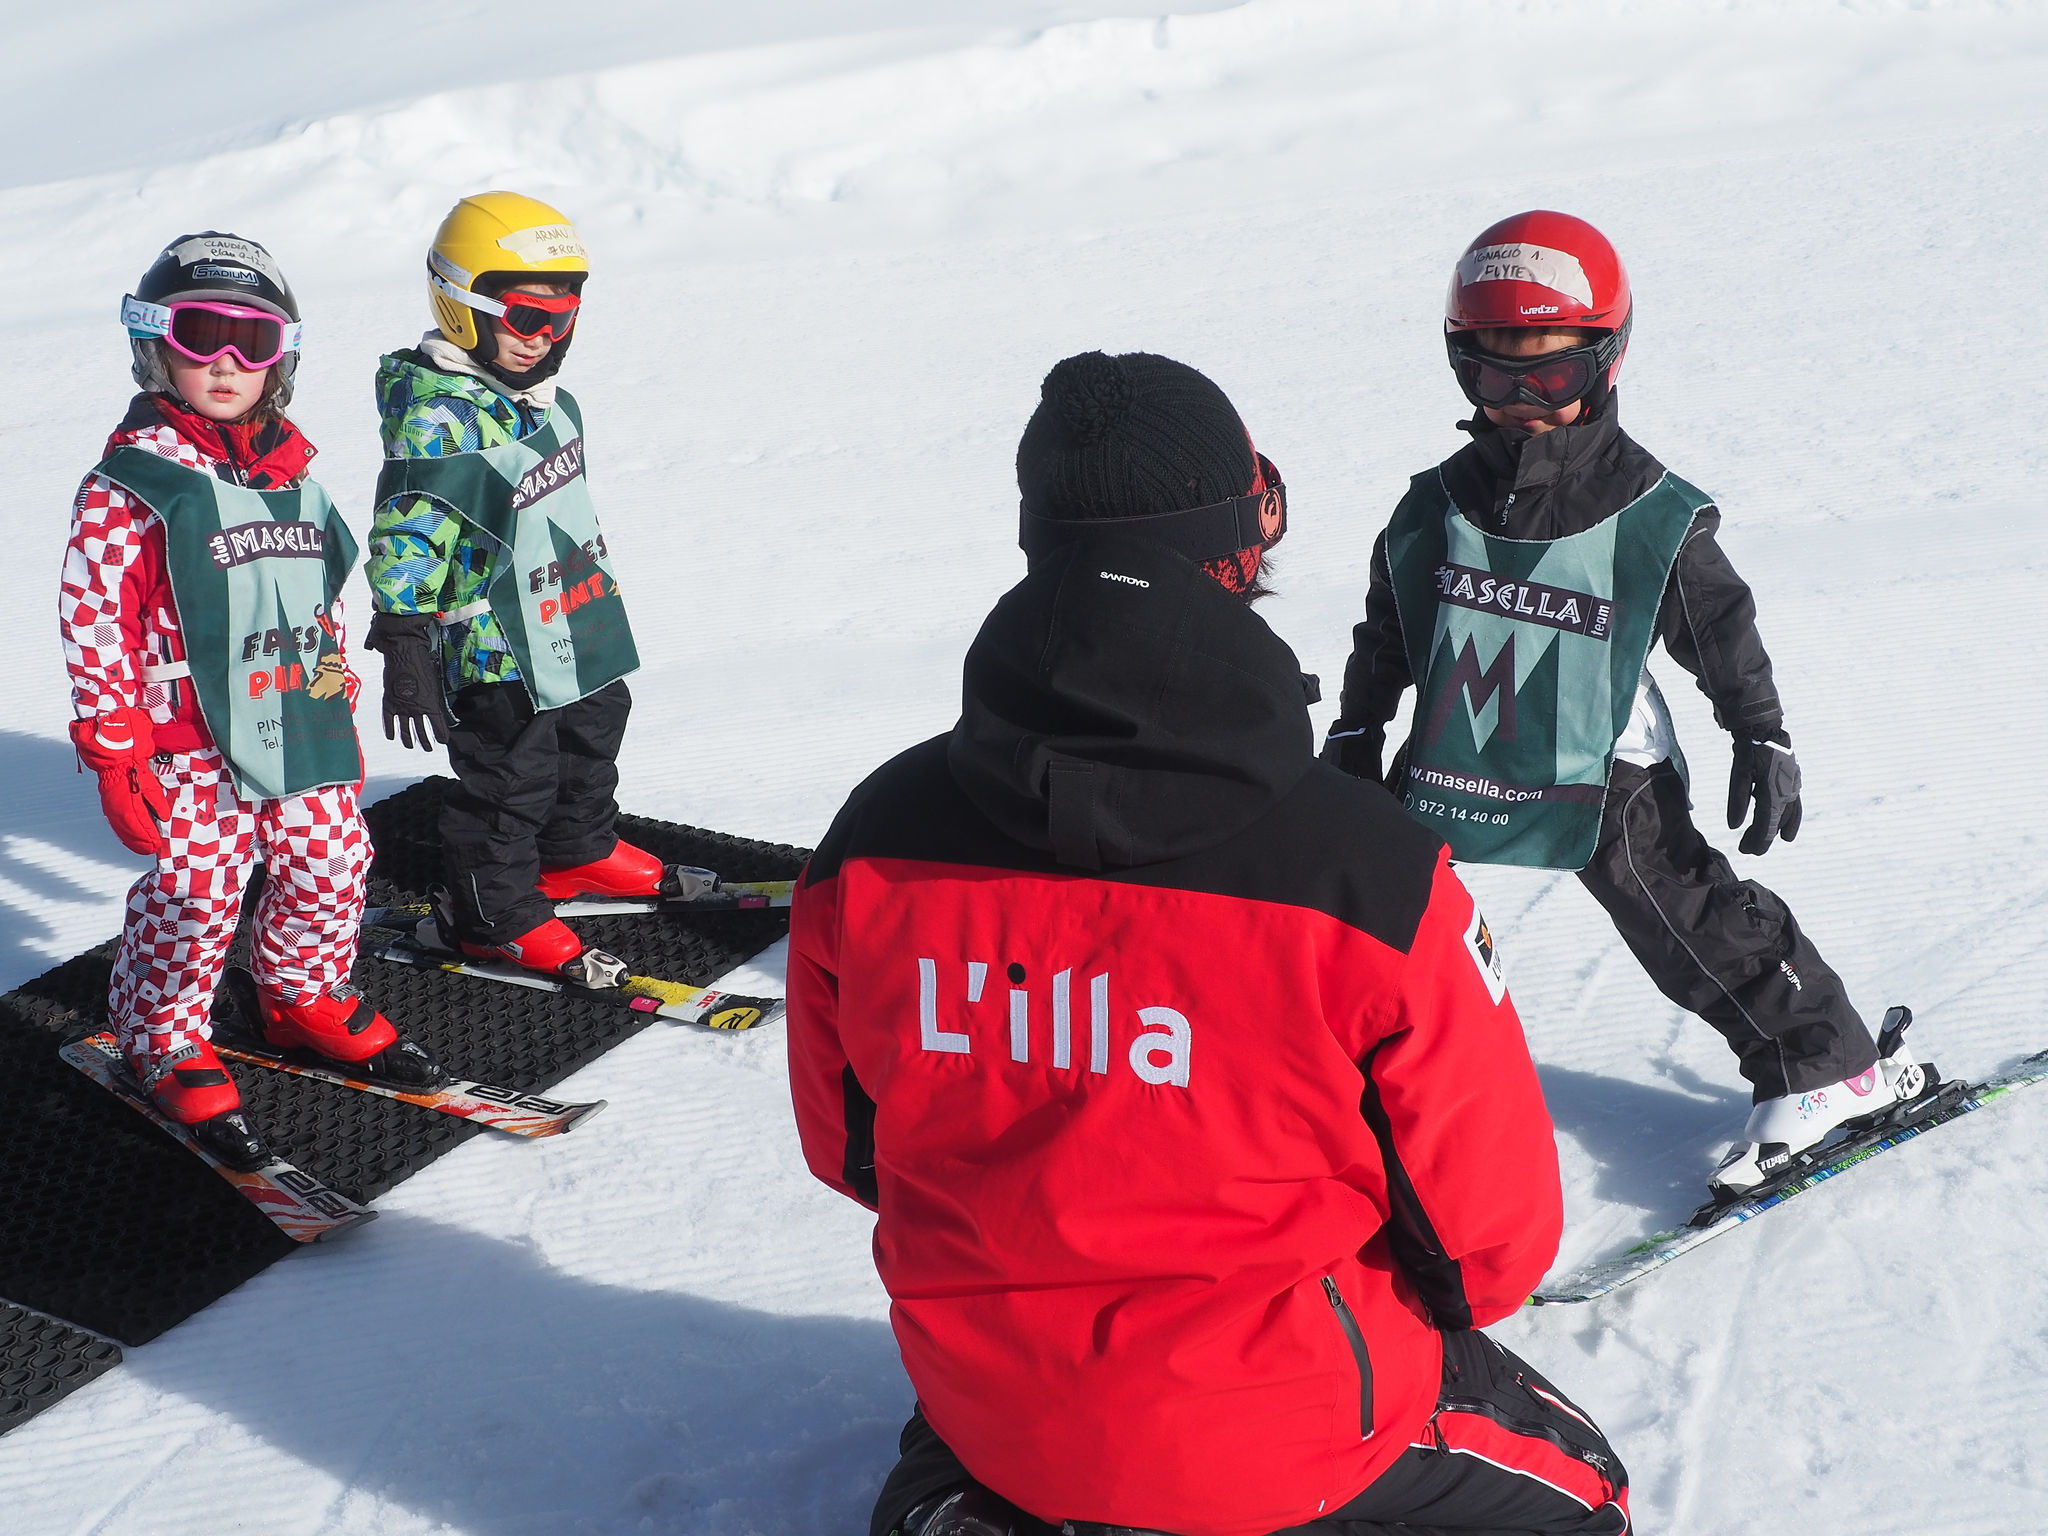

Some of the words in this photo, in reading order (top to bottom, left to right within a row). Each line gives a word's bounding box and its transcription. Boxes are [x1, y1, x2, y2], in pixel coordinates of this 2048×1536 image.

[535, 227, 569, 242] ARNAU
[1473, 248, 1522, 264] IGNACIO
[197, 267, 254, 281] STADIUM
[1100, 571, 1150, 588] SANTOYO
[242, 625, 320, 663] FAES
[557, 649, 575, 665] Tel.
[249, 661, 303, 700] PIN
[262, 736, 283, 751] Tel.
[1419, 800, 1445, 817] 972
[1450, 806, 1467, 820] 14
[1470, 810, 1488, 824] 40
[1492, 813, 1510, 826] 00
[917, 957, 1192, 1089] L'illa
[1758, 1151, 1789, 1171] TC45
